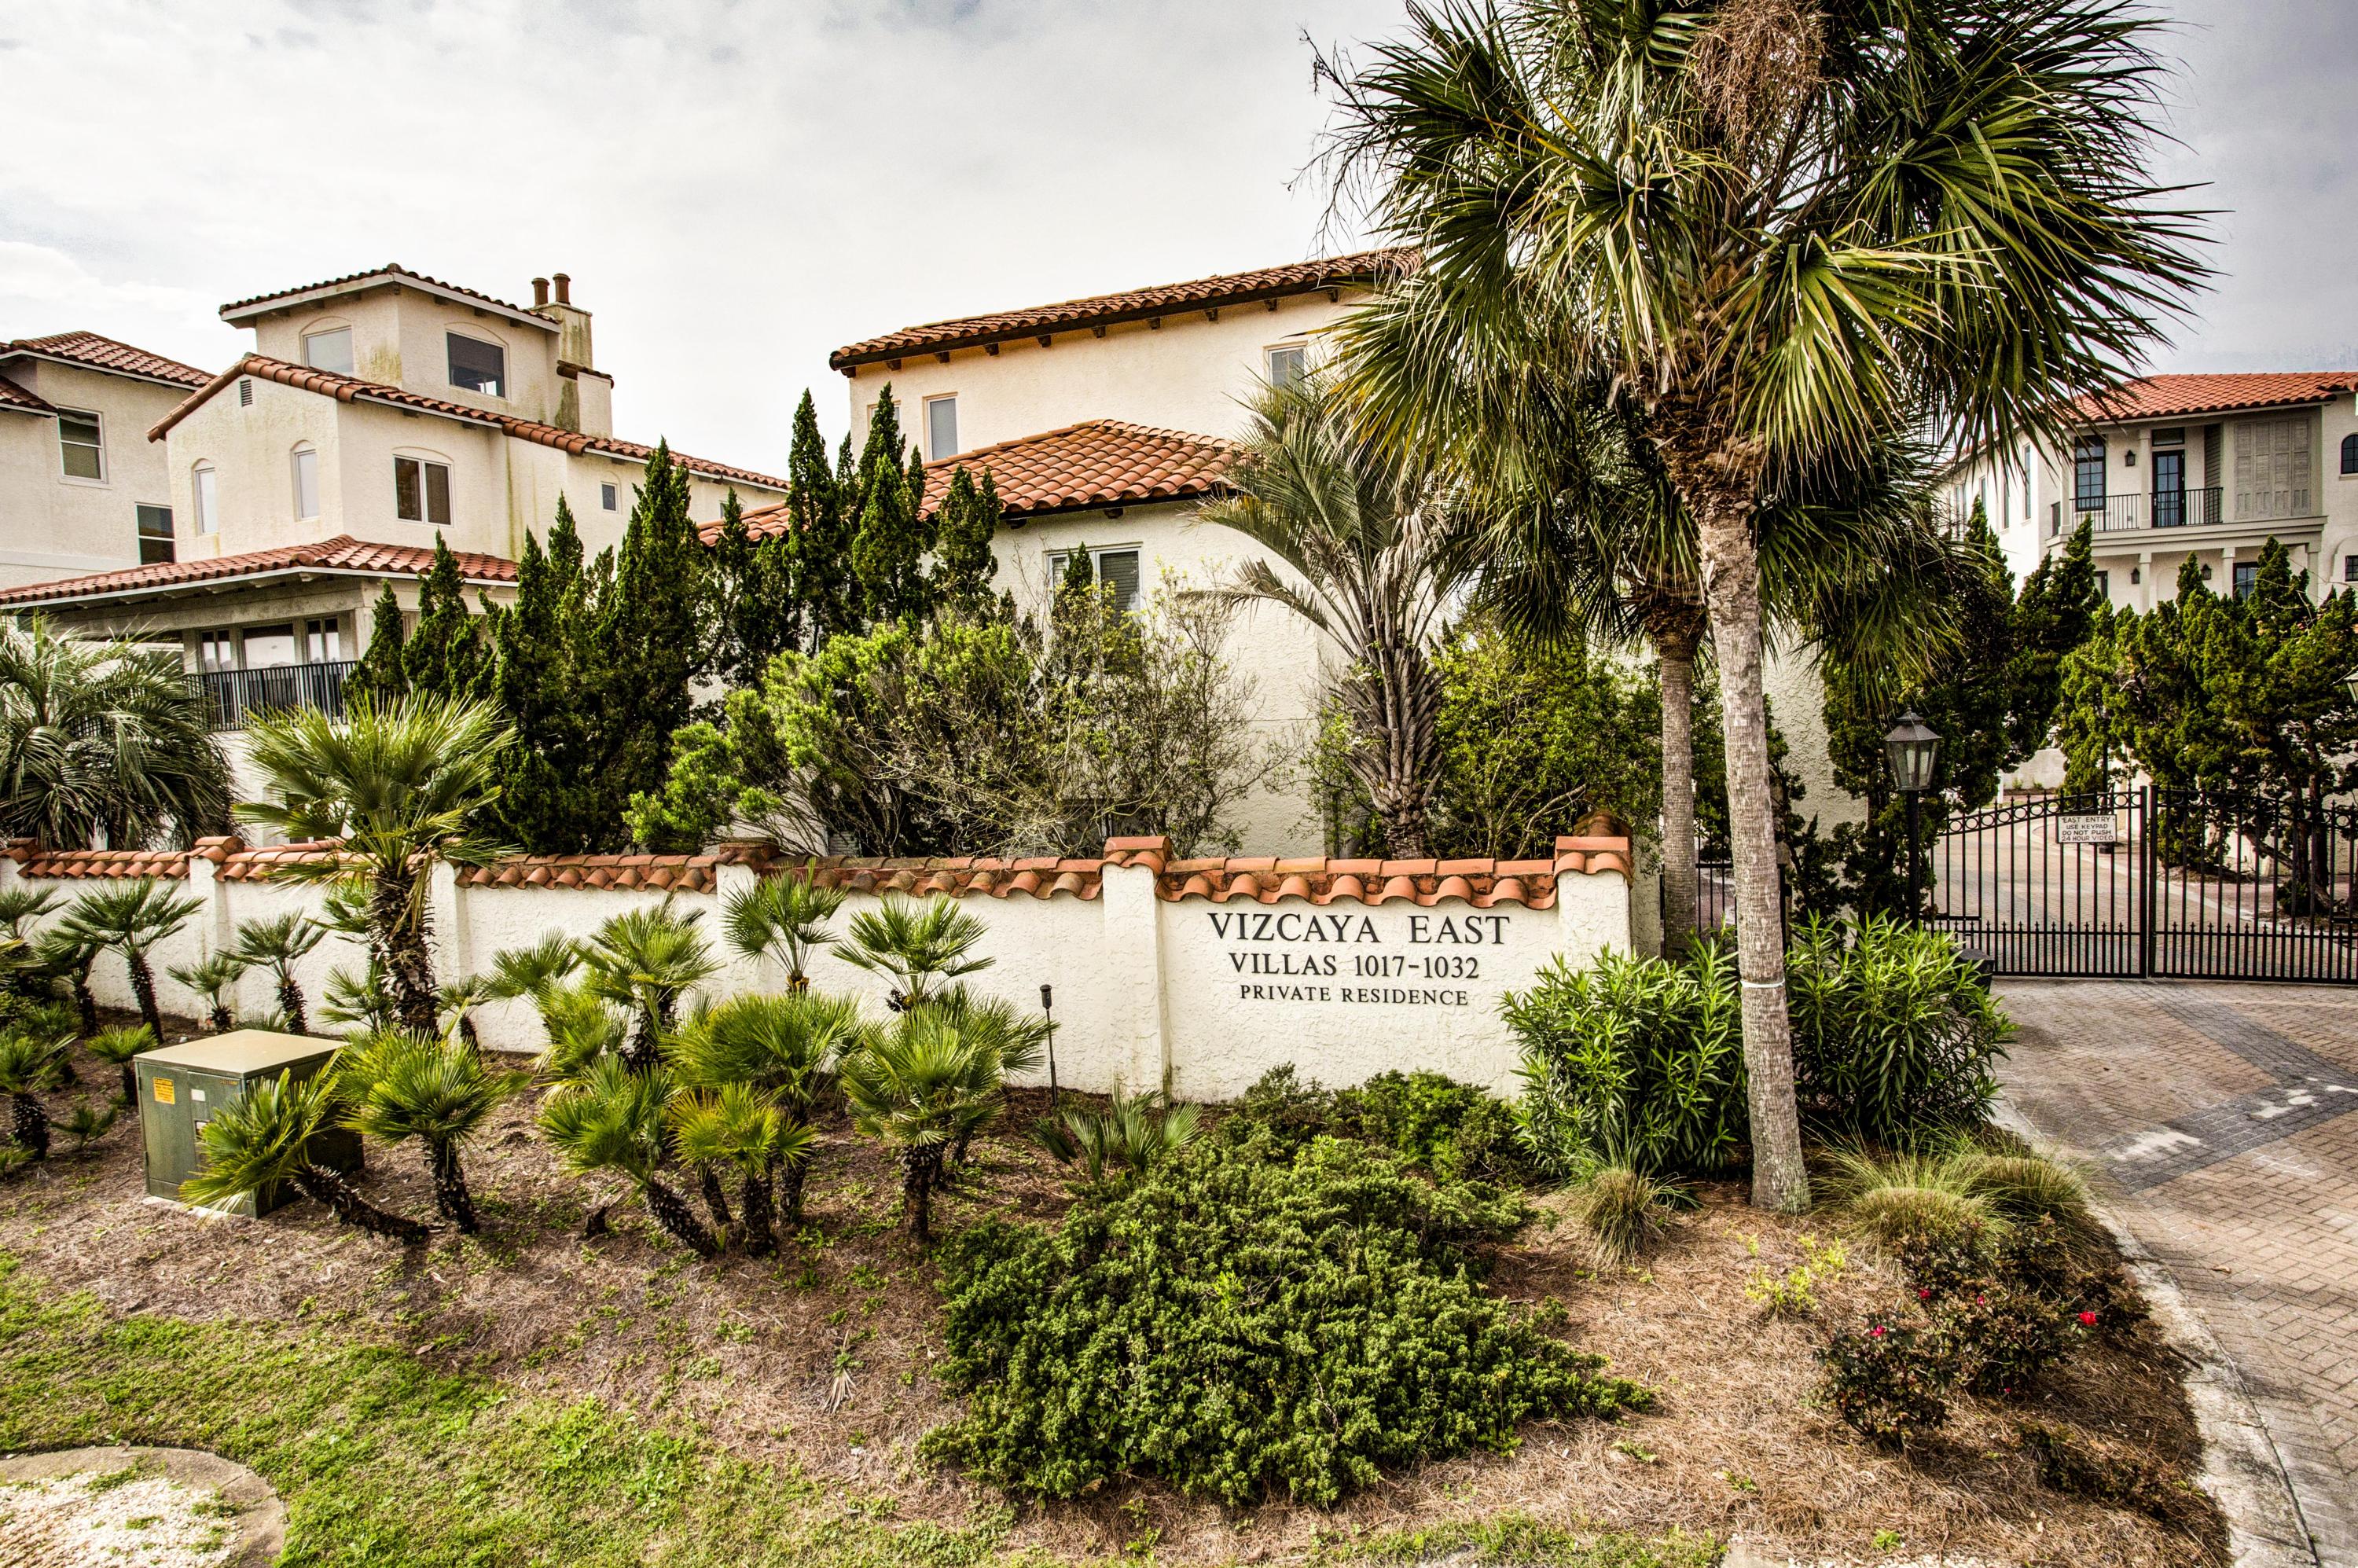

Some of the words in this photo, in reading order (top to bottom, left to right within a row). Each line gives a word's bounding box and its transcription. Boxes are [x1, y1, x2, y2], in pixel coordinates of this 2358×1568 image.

[1207, 913, 1381, 943] VIZCAYA
[1408, 916, 1510, 945] EAST
[1229, 953, 1337, 976] VILLAS
[1355, 955, 1479, 979] 1017-1032
[1240, 985, 1331, 1001] PRIVATE
[1341, 988, 1468, 1006] RESIDENCE
